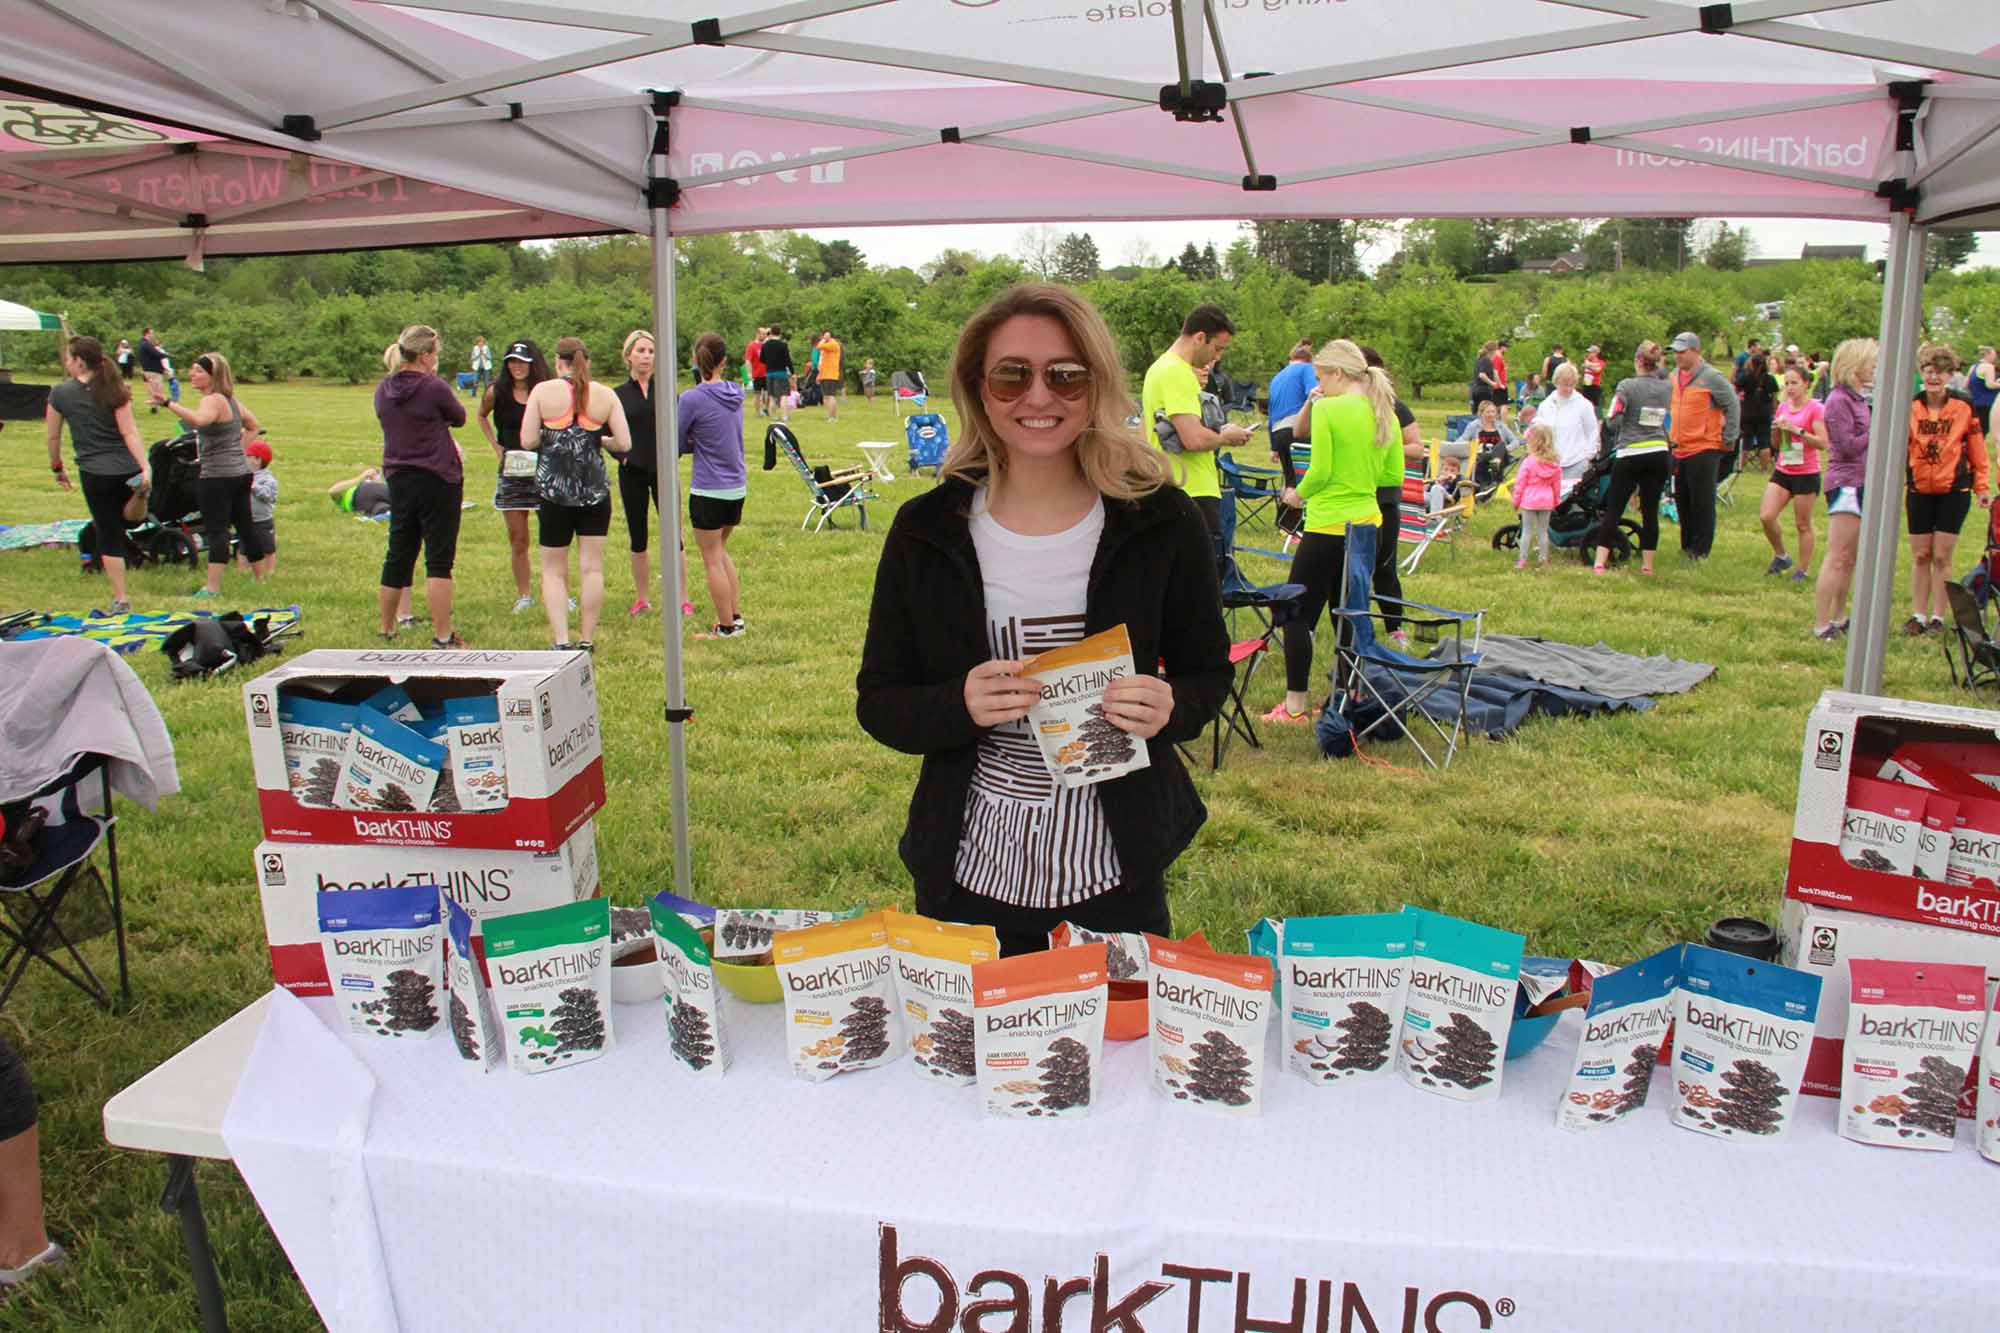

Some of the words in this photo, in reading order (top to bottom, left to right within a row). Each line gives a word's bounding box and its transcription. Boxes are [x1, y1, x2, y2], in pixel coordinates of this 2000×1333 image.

[1040, 665, 1124, 701] arkTHINS
[356, 736, 426, 785] barkTHINS
[353, 815, 451, 839] barkTHINS
[334, 935, 433, 957] barkTHINS
[499, 948, 602, 985] barkTHINS
[787, 955, 891, 992] barkTHINS
[1293, 963, 1401, 989] barkTHINS
[1156, 973, 1258, 1022] barkTHINS
[986, 998, 1097, 1033] barkTHINS
[1008, 1027, 1043, 1038] snacking
[1687, 1001, 1799, 1050] barkTHINS
[1860, 1013, 1978, 1044] barkTHINS
[1880, 1039, 1914, 1050] snacking
